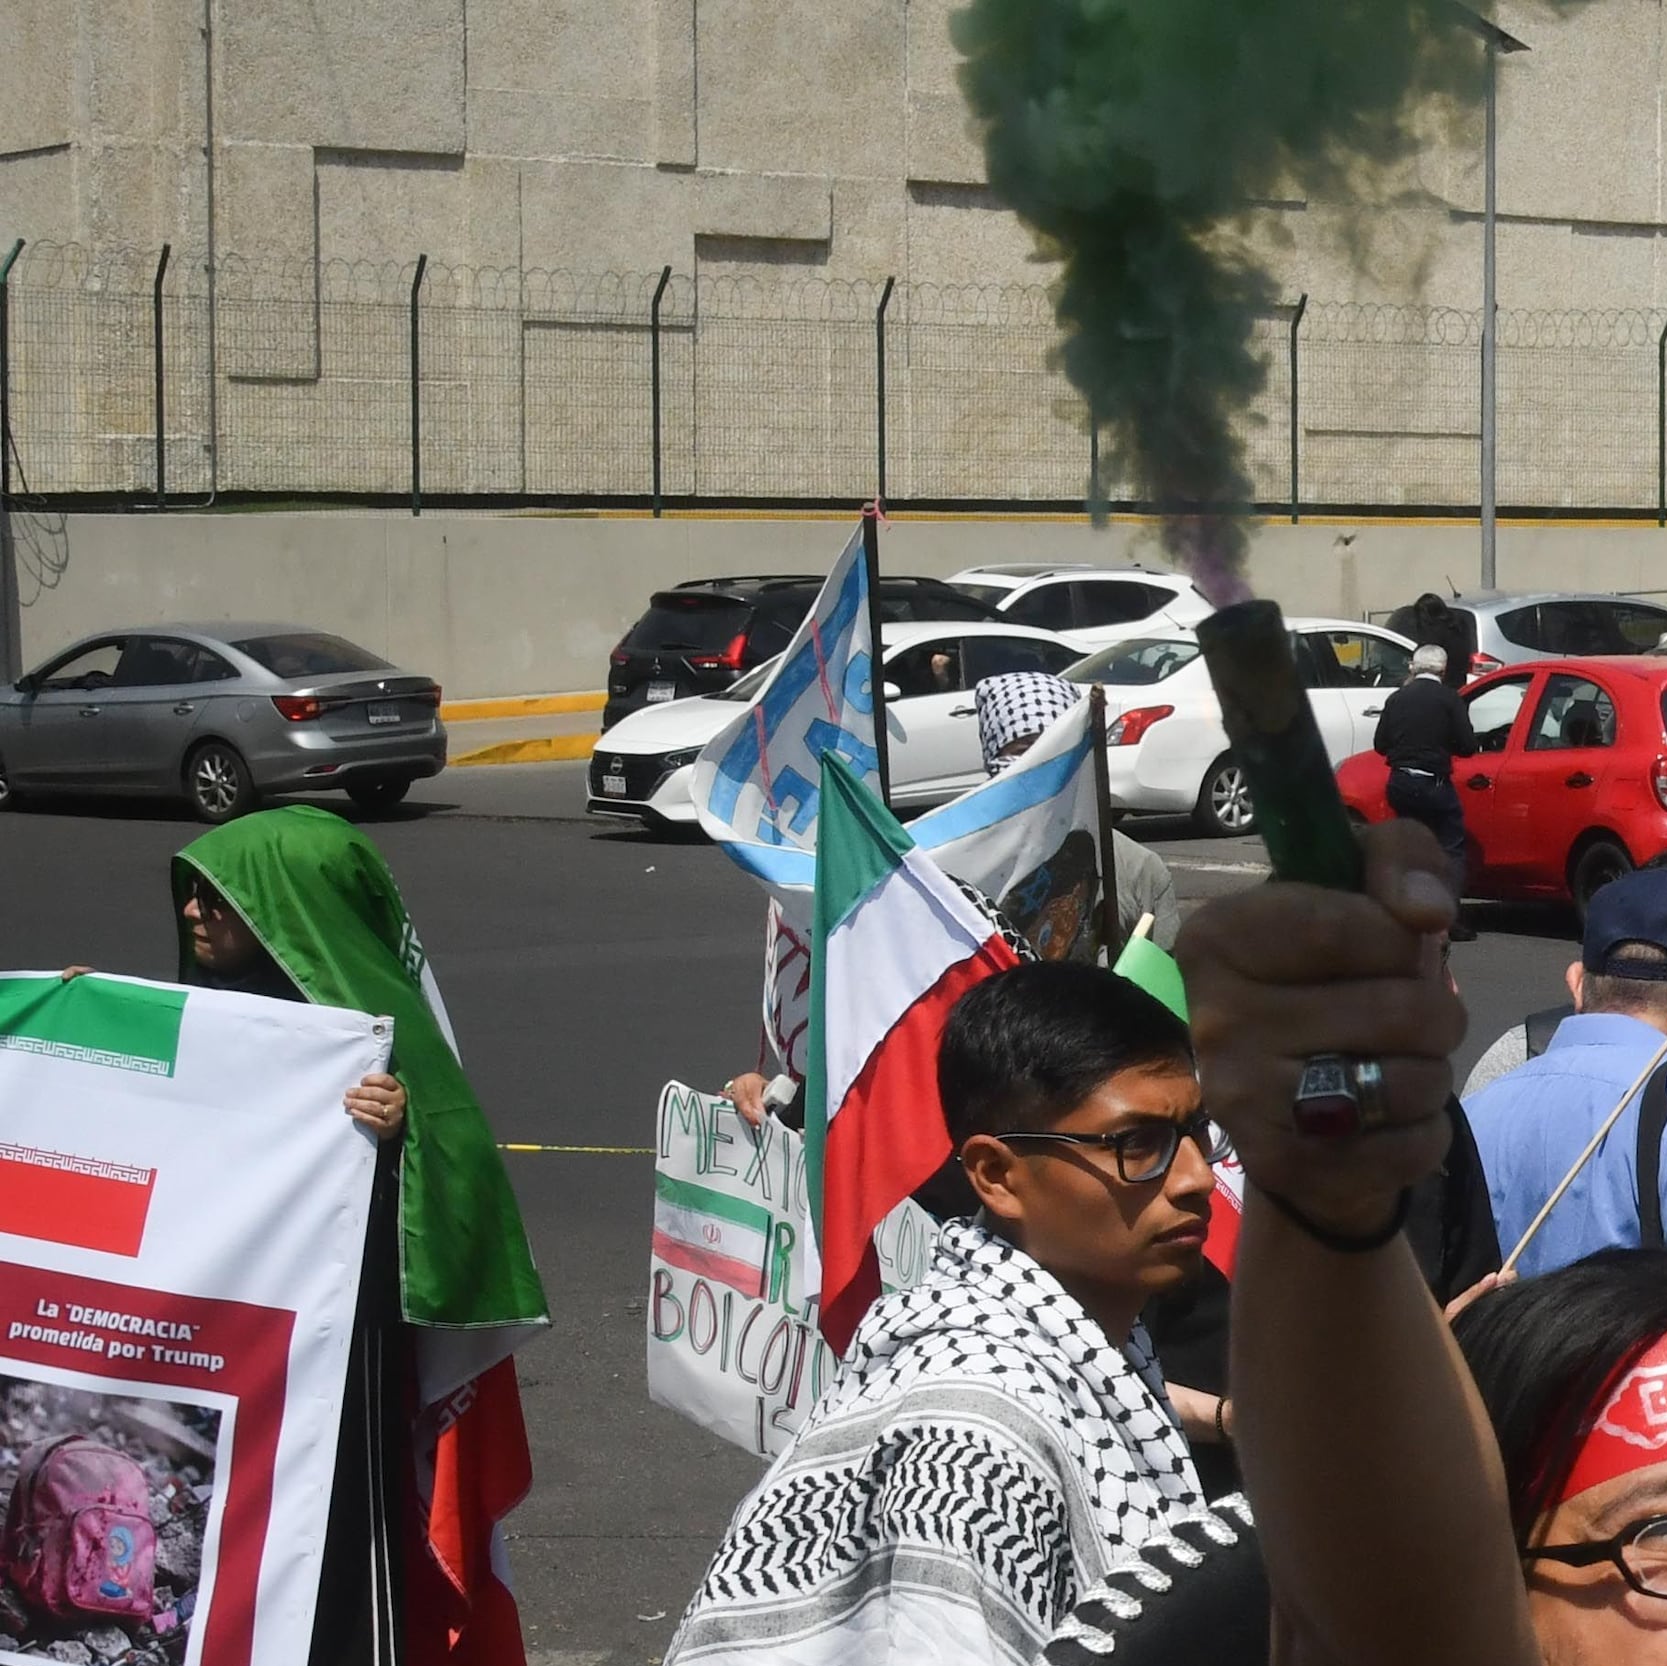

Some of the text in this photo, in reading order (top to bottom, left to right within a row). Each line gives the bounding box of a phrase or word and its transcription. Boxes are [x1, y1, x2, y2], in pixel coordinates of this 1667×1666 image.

[37, 1298, 59, 1319] La
[9, 1321, 224, 1372] prometida por Trump
